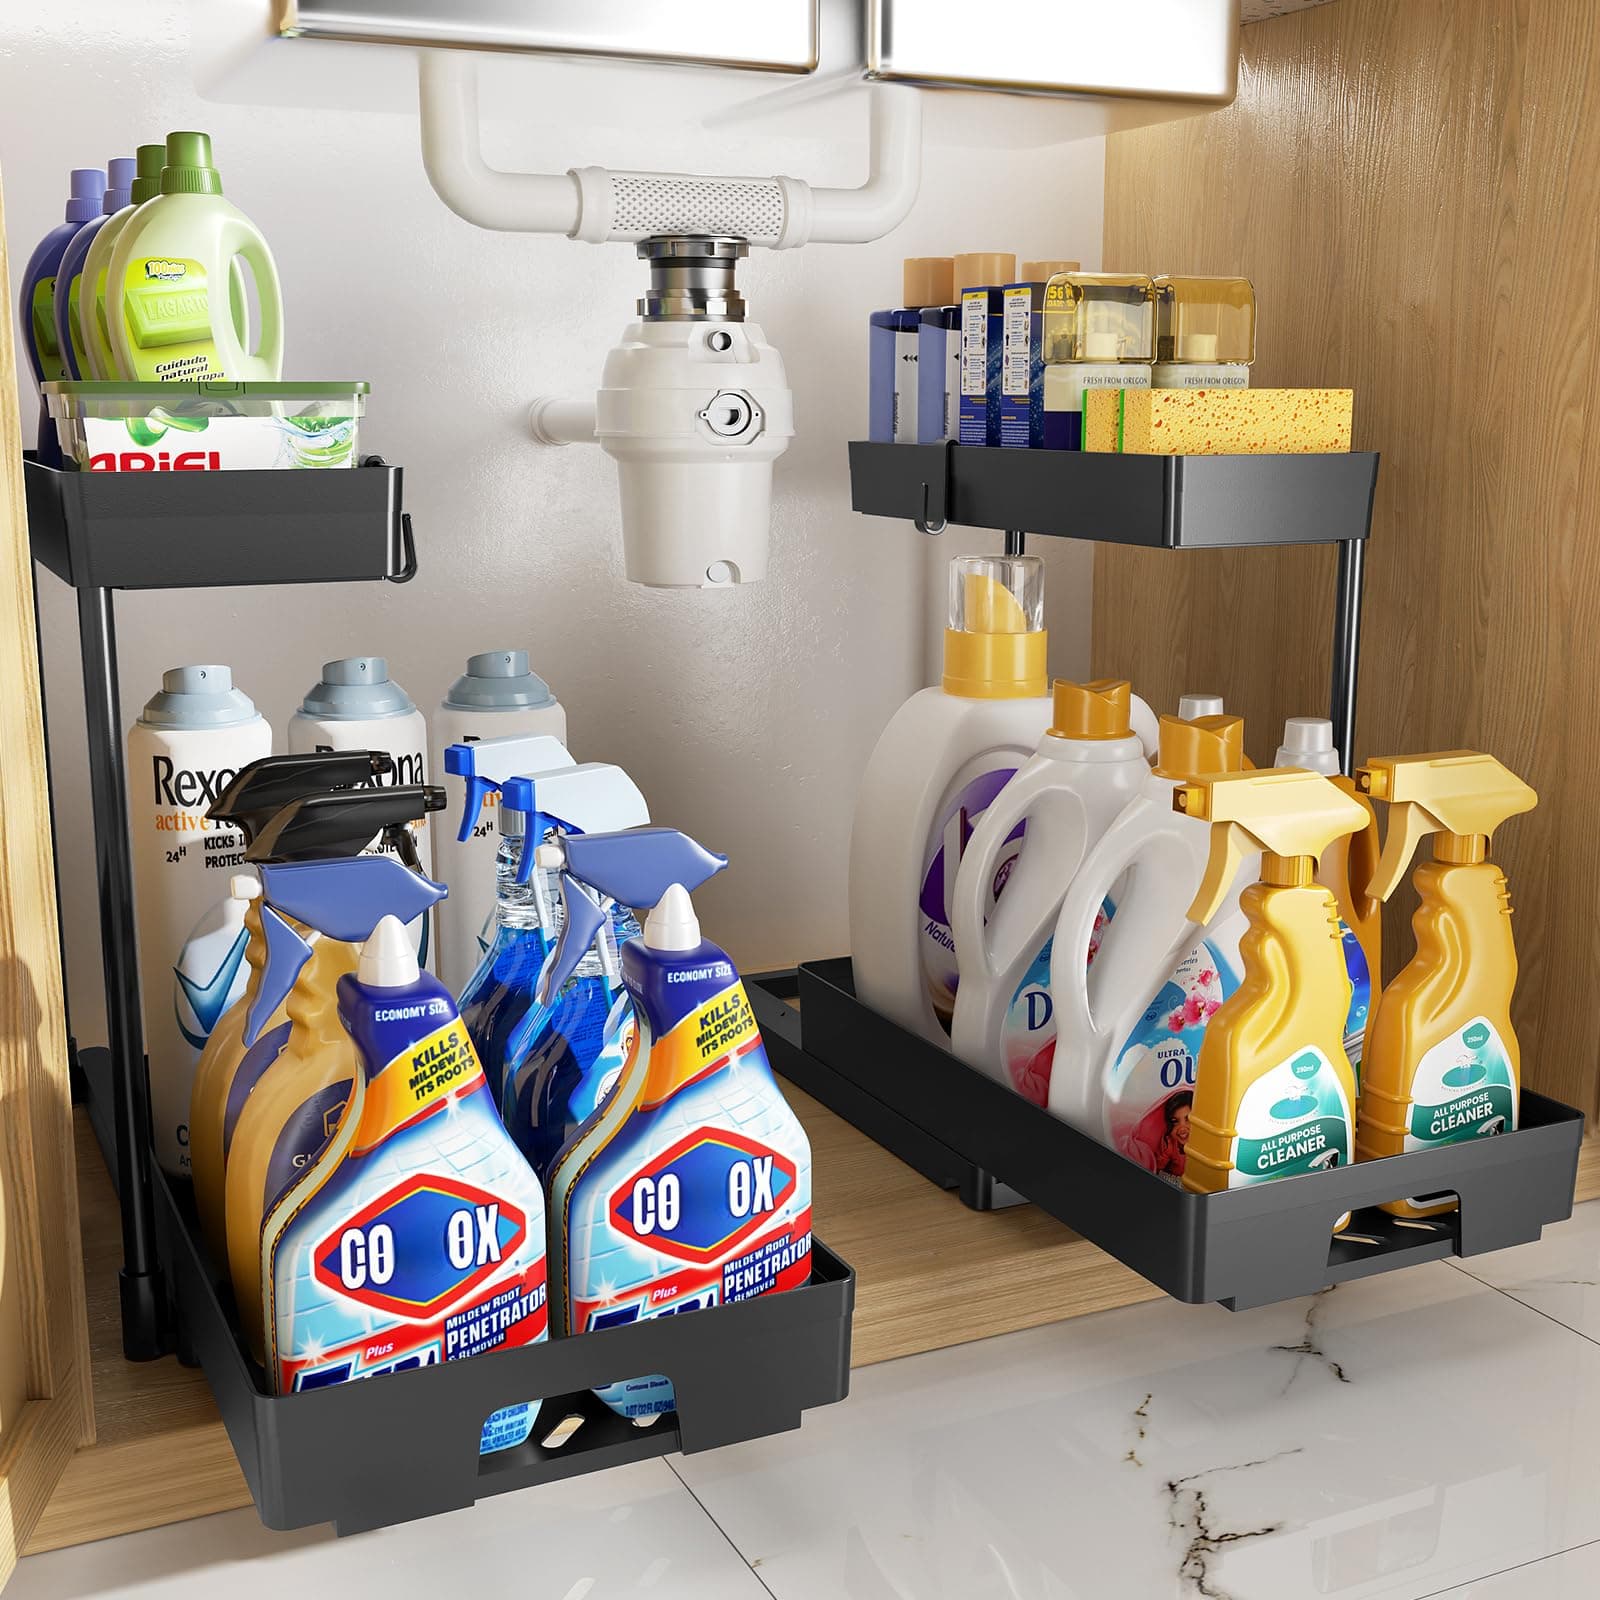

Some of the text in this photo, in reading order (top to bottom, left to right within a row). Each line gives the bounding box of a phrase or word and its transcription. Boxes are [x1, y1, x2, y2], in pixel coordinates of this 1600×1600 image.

[156, 356, 207, 374] Cuidado
[161, 364, 208, 382] natural
[1083, 376, 1147, 385] FRESH FROM OREGON
[1184, 376, 1245, 385] FRESH FROM OREGON
[155, 811, 210, 831] active
[204, 834, 235, 850] KICKS
[205, 852, 248, 868] PROTEC
[667, 964, 733, 983] ECONOMY SIZE
[375, 1001, 449, 1021] ECONOMY SIZE
[699, 994, 740, 1031] KILLS
[696, 1003, 750, 1048] MILDEW AT
[702, 1016, 754, 1058] ITS ROOTS
[409, 1041, 470, 1090] MILDEW AT
[412, 1032, 459, 1072] KILLS
[1157, 1048, 1185, 1059] ULTRA
[416, 1056, 475, 1101] ITS ROOTS
[1430, 1102, 1493, 1134] CLEANER
[1433, 1092, 1489, 1119] ALL PURPOSE
[1257, 1134, 1326, 1169] CLEANER
[1260, 1124, 1321, 1153] ALL PURPOSE
[725, 1235, 790, 1274] MILDEW ROOT
[725, 1232, 811, 1297] PENETRATOR
[652, 1286, 678, 1301] Plus
[734, 1278, 775, 1302] REMOVER
[446, 1286, 521, 1330] MILDEW ROOT
[447, 1282, 547, 1354] PENETRATOR
[365, 1342, 394, 1360] Plus
[459, 1333, 505, 1360] REMOVER
